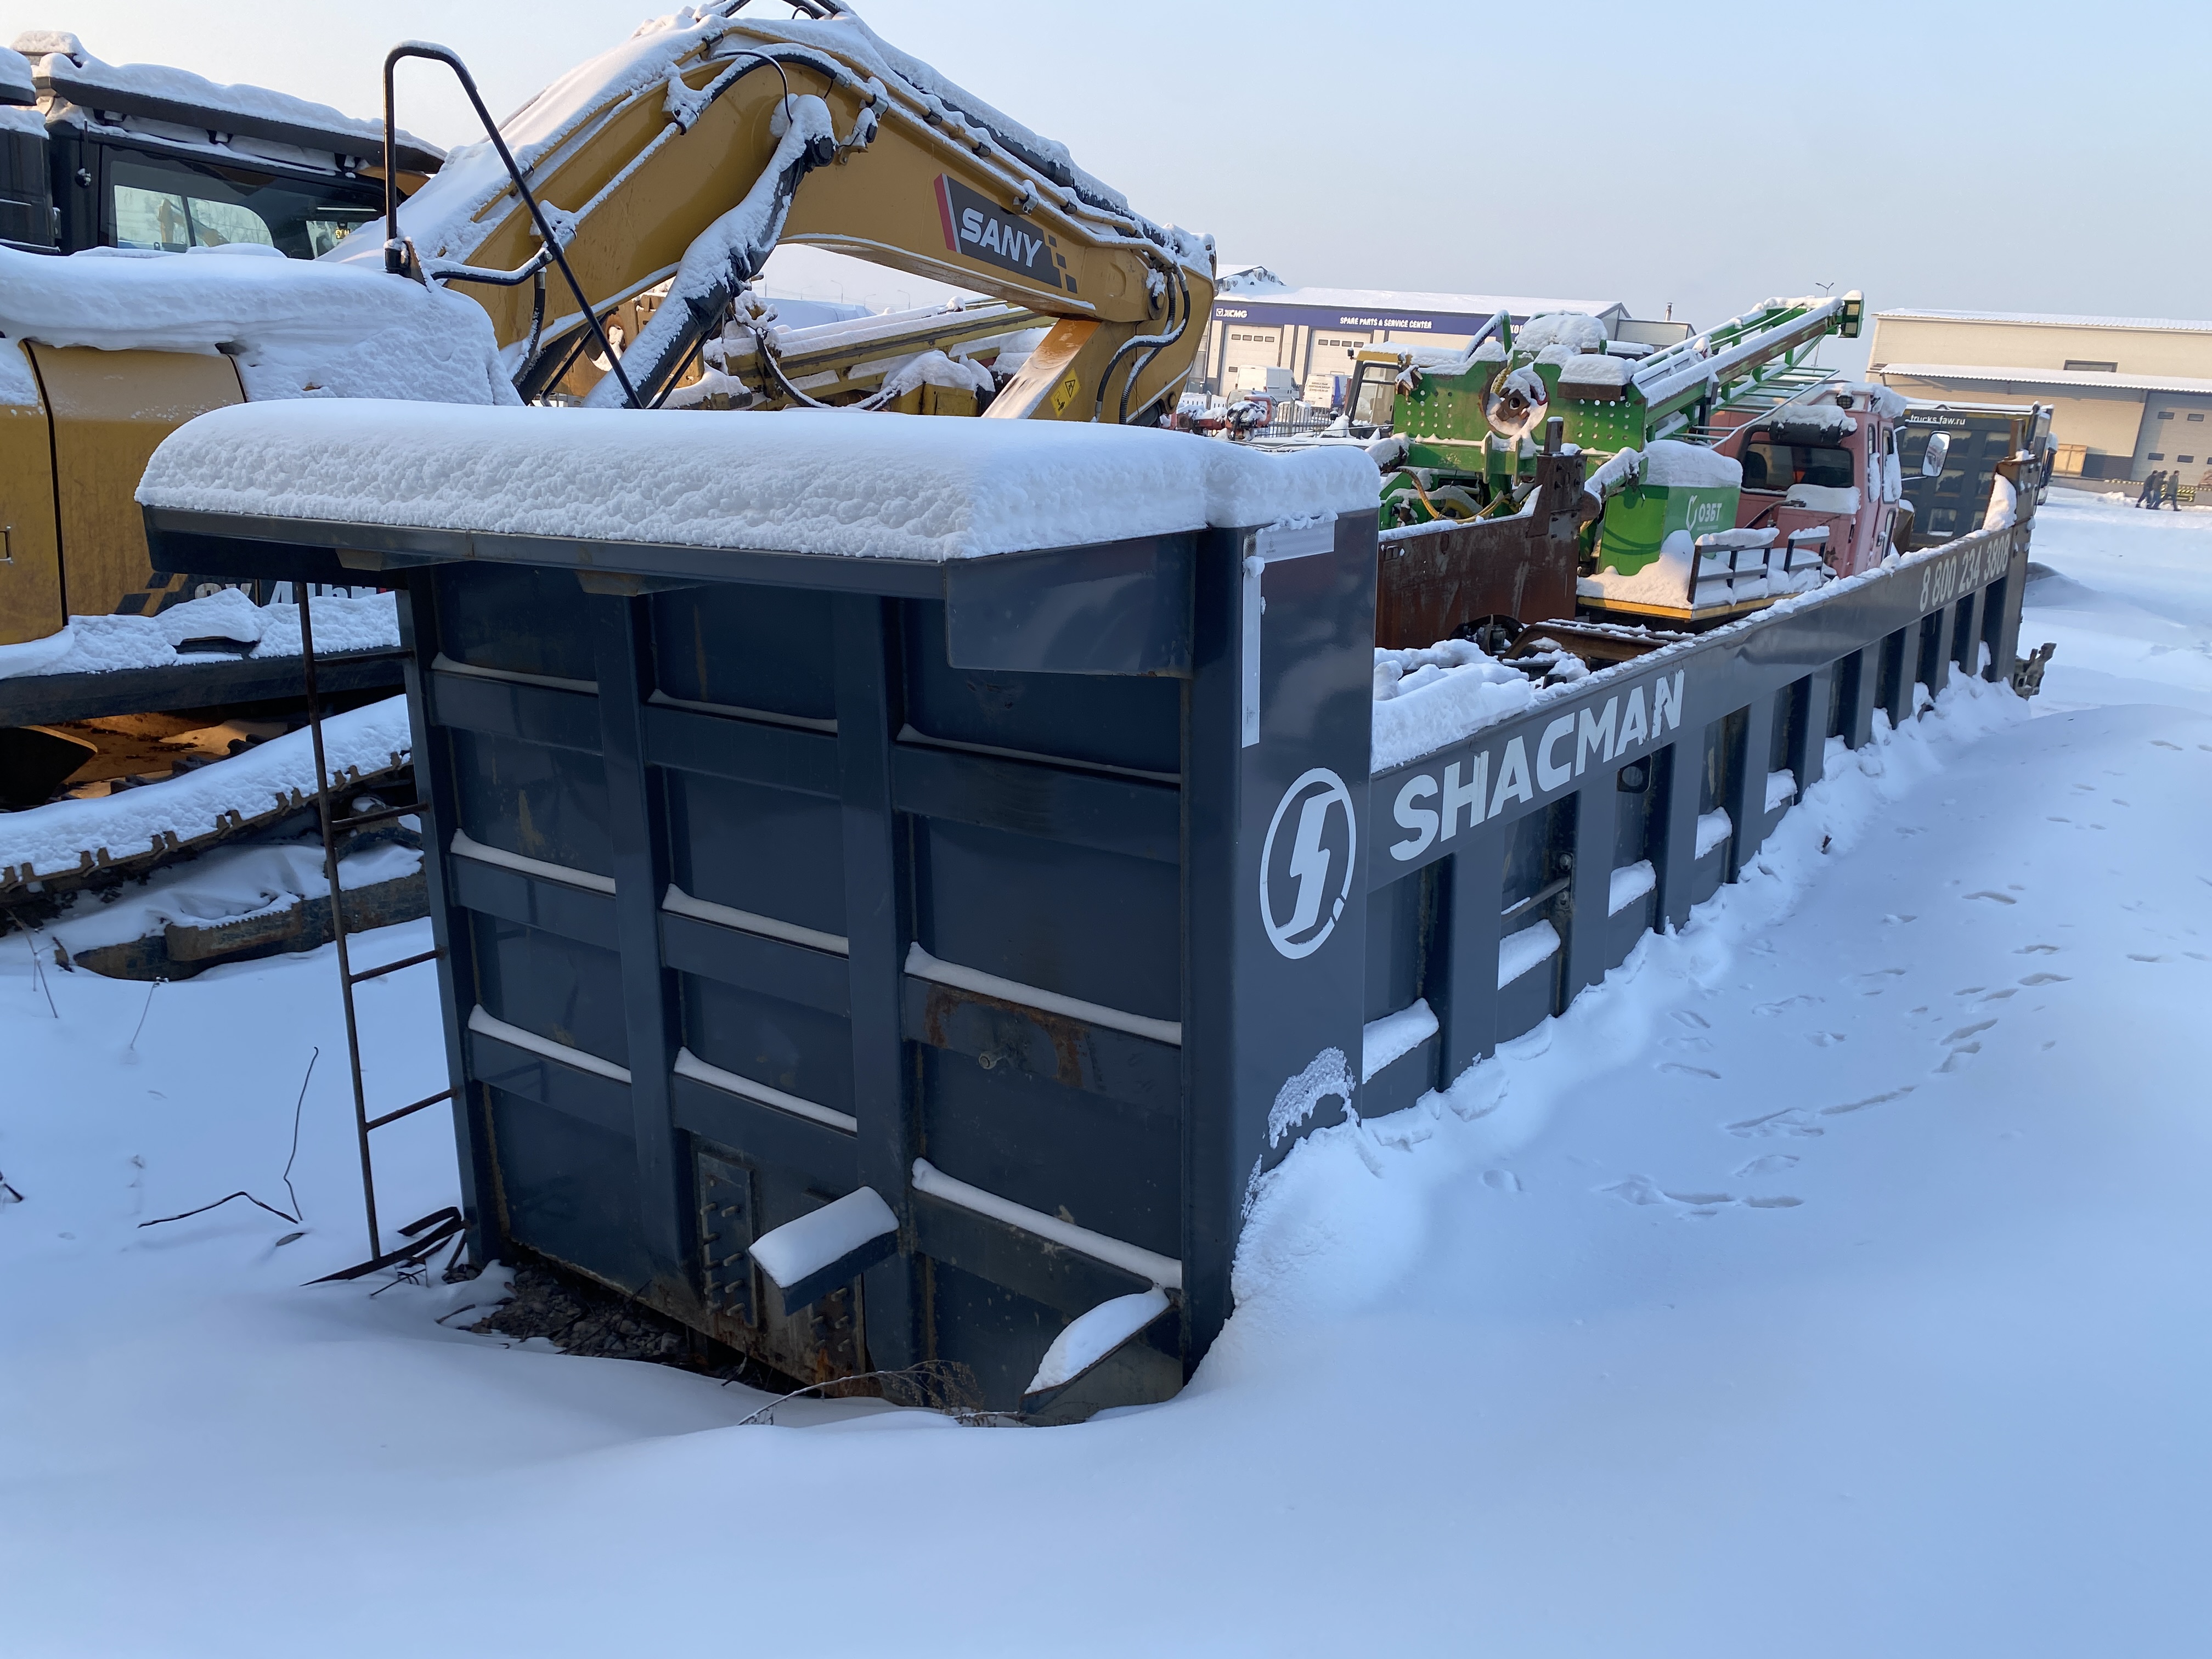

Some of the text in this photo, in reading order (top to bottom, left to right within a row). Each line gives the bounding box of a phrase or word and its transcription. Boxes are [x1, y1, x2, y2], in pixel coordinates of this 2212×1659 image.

[961, 207, 1043, 268] SANY
[1223, 309, 1248, 318] XCMG
[1340, 317, 1358, 325] SPARE
[1359, 318, 1378, 326] PARTS
[1384, 319, 1409, 328] SERVICE
[1409, 320, 1432, 329] CENTER
[1699, 503, 1723, 522] ОЗБТ
[1920, 533, 2011, 613] 8 800 234 3808
[1390, 669, 1685, 861] SHACMAN
